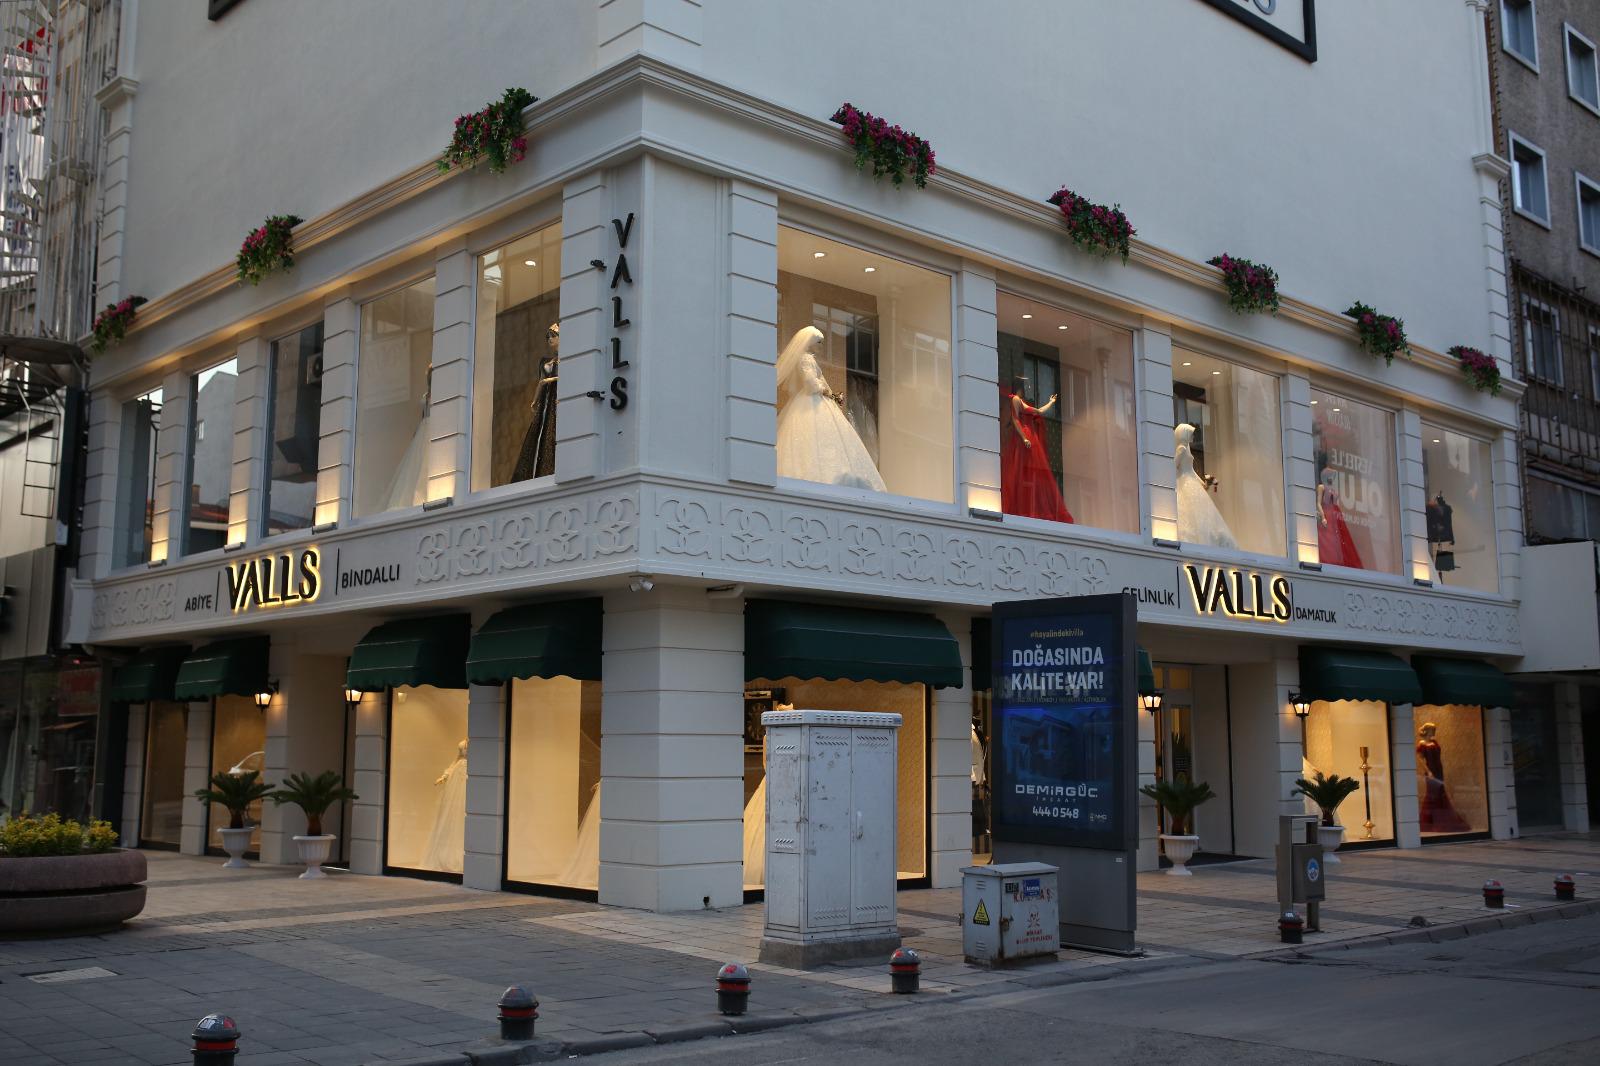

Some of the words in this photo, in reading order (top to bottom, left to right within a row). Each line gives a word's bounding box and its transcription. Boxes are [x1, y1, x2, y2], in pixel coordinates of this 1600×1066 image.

[611, 212, 635, 410] VALLS
[226, 549, 319, 611] VALLS
[341, 563, 400, 589] BİNDALLI
[185, 594, 212, 612] ABİYE
[1186, 565, 1292, 621] VALLS
[1012, 643, 1105, 667] DOĞASINDA
[1066, 671, 1104, 690] VAR!
[1032, 805, 1050, 817] 444
[1052, 807, 1059, 817] 0
[1060, 807, 1079, 819] 548
